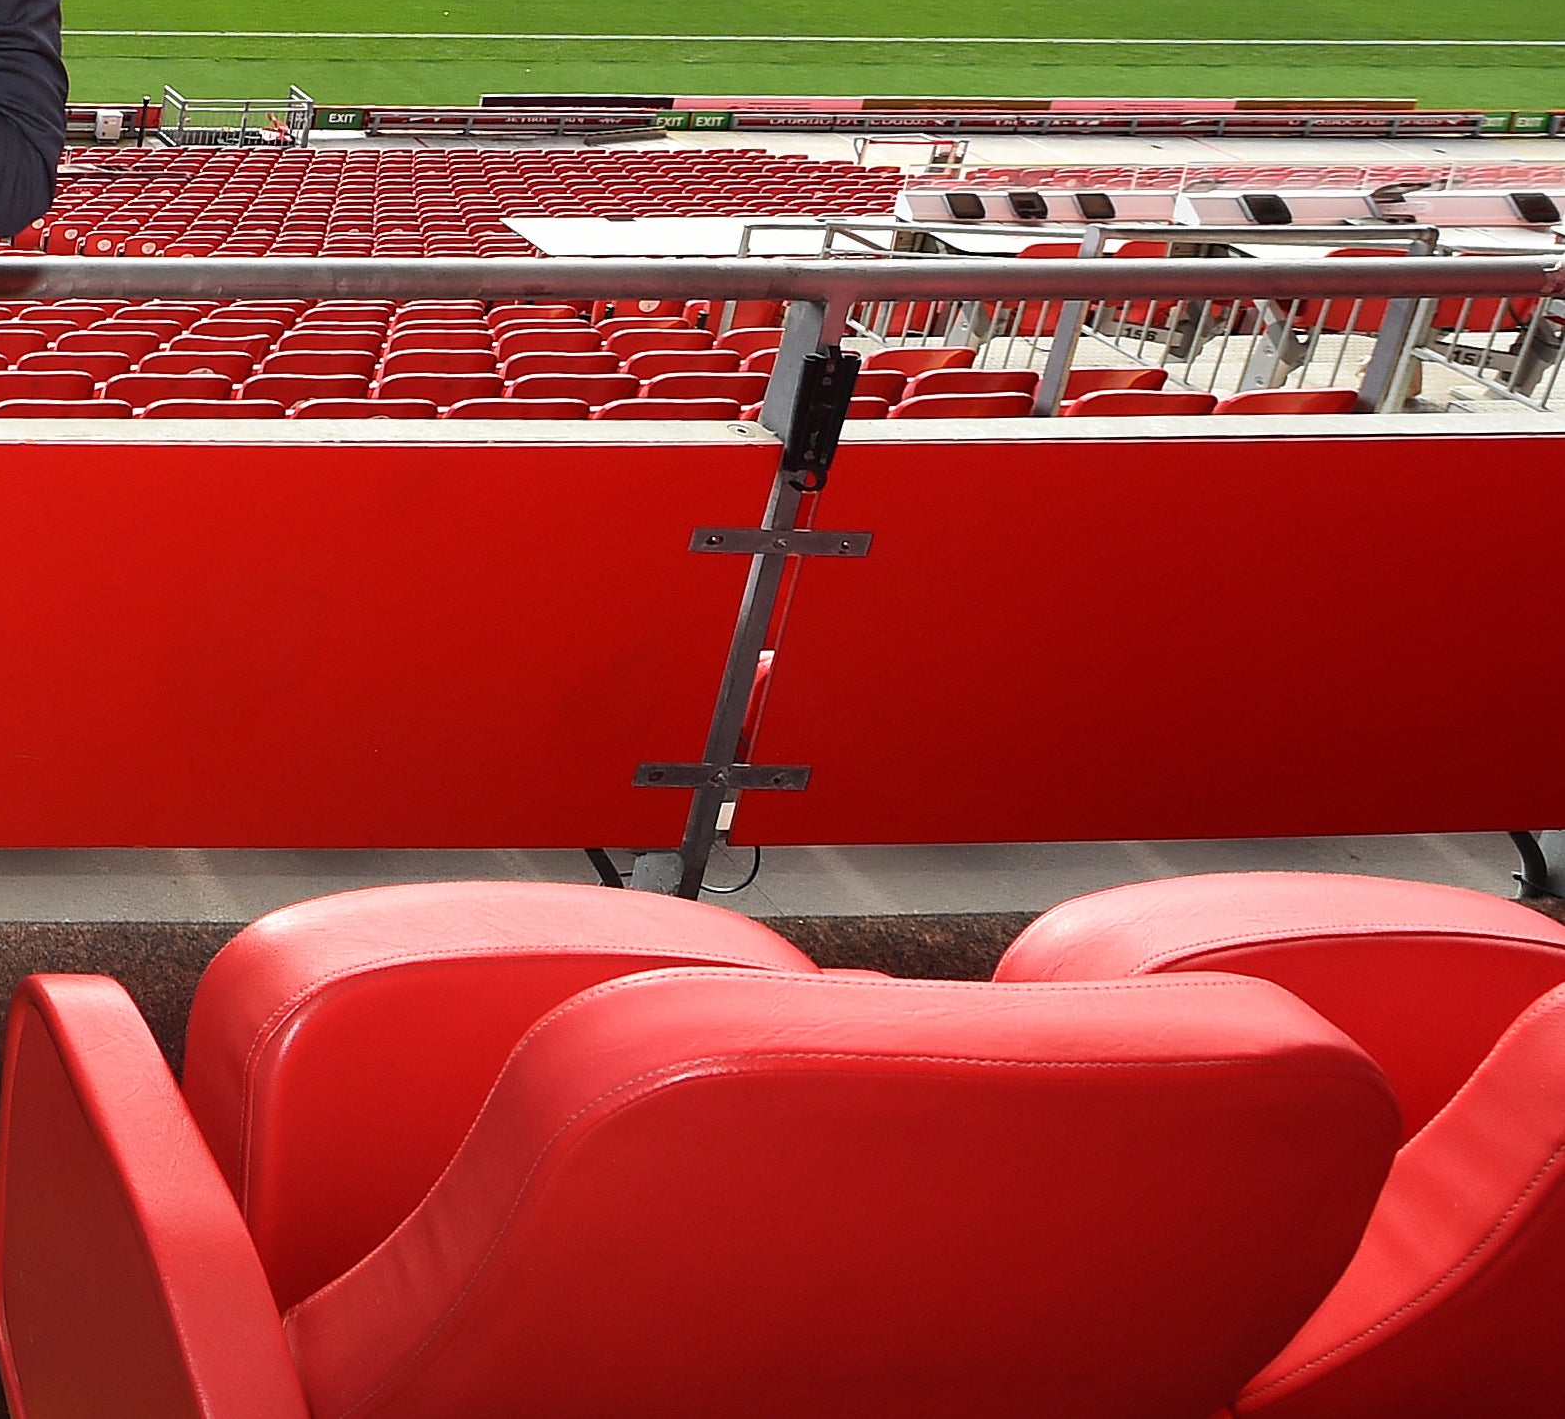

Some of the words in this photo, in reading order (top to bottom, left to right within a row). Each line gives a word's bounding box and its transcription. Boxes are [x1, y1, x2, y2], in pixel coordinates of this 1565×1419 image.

[328, 113, 357, 124] EXIT
[655, 115, 684, 128] EXIT
[694, 115, 726, 128] EXIT
